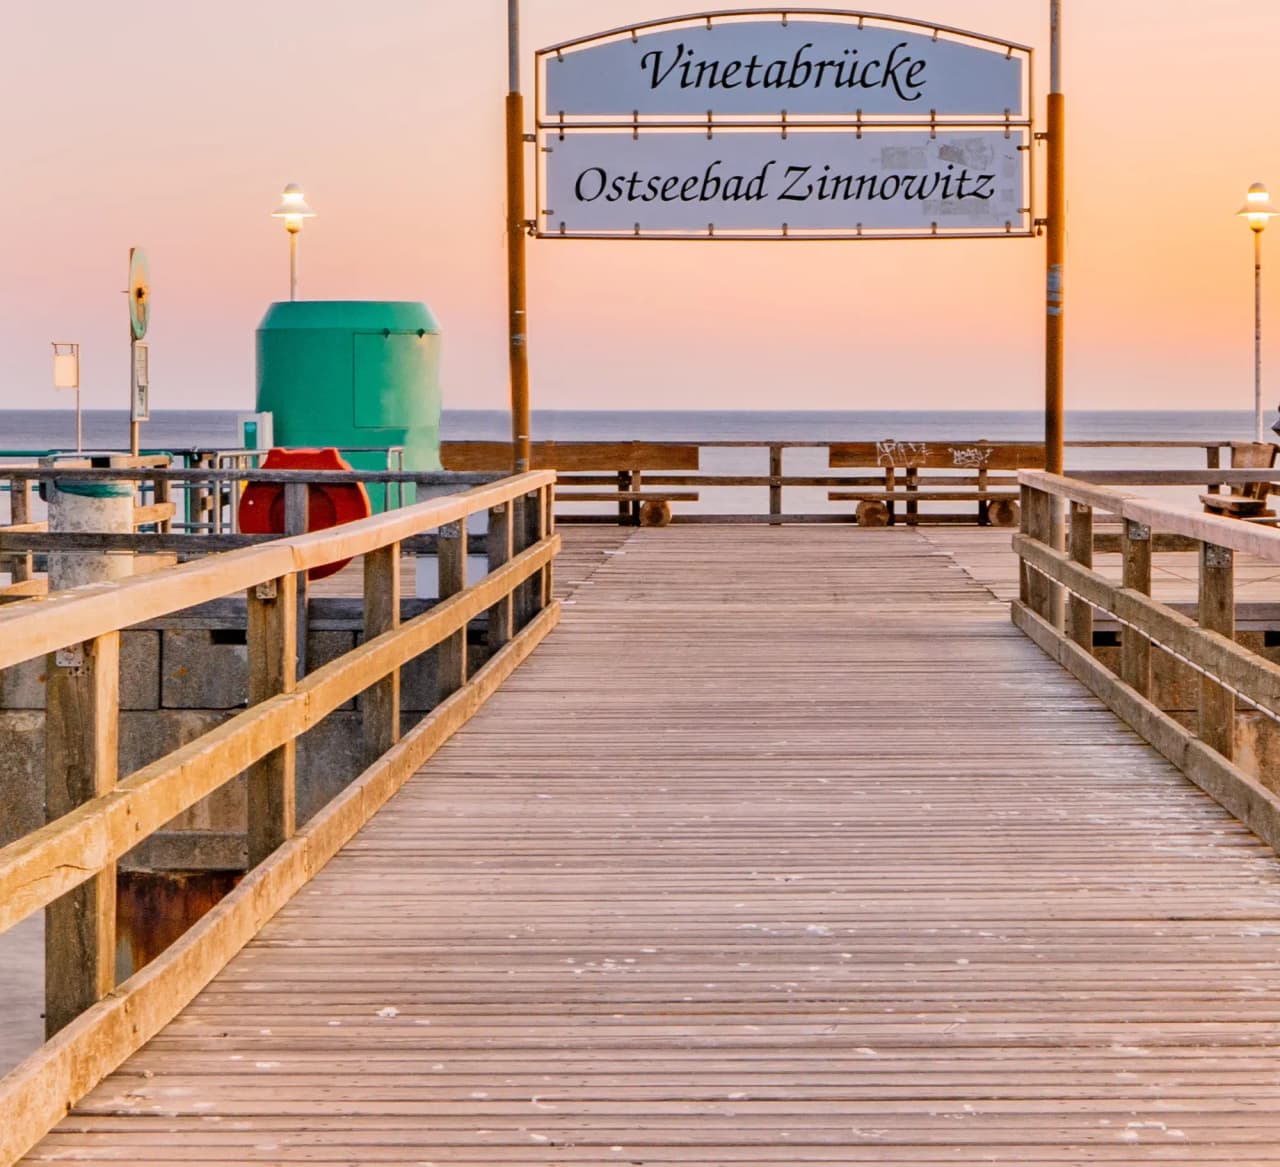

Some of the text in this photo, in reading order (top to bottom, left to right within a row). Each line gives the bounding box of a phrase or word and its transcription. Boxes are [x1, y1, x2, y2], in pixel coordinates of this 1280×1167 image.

[640, 42, 927, 101] Vinetabrücke
[575, 160, 995, 201] Ostseebad Zinnowitz
